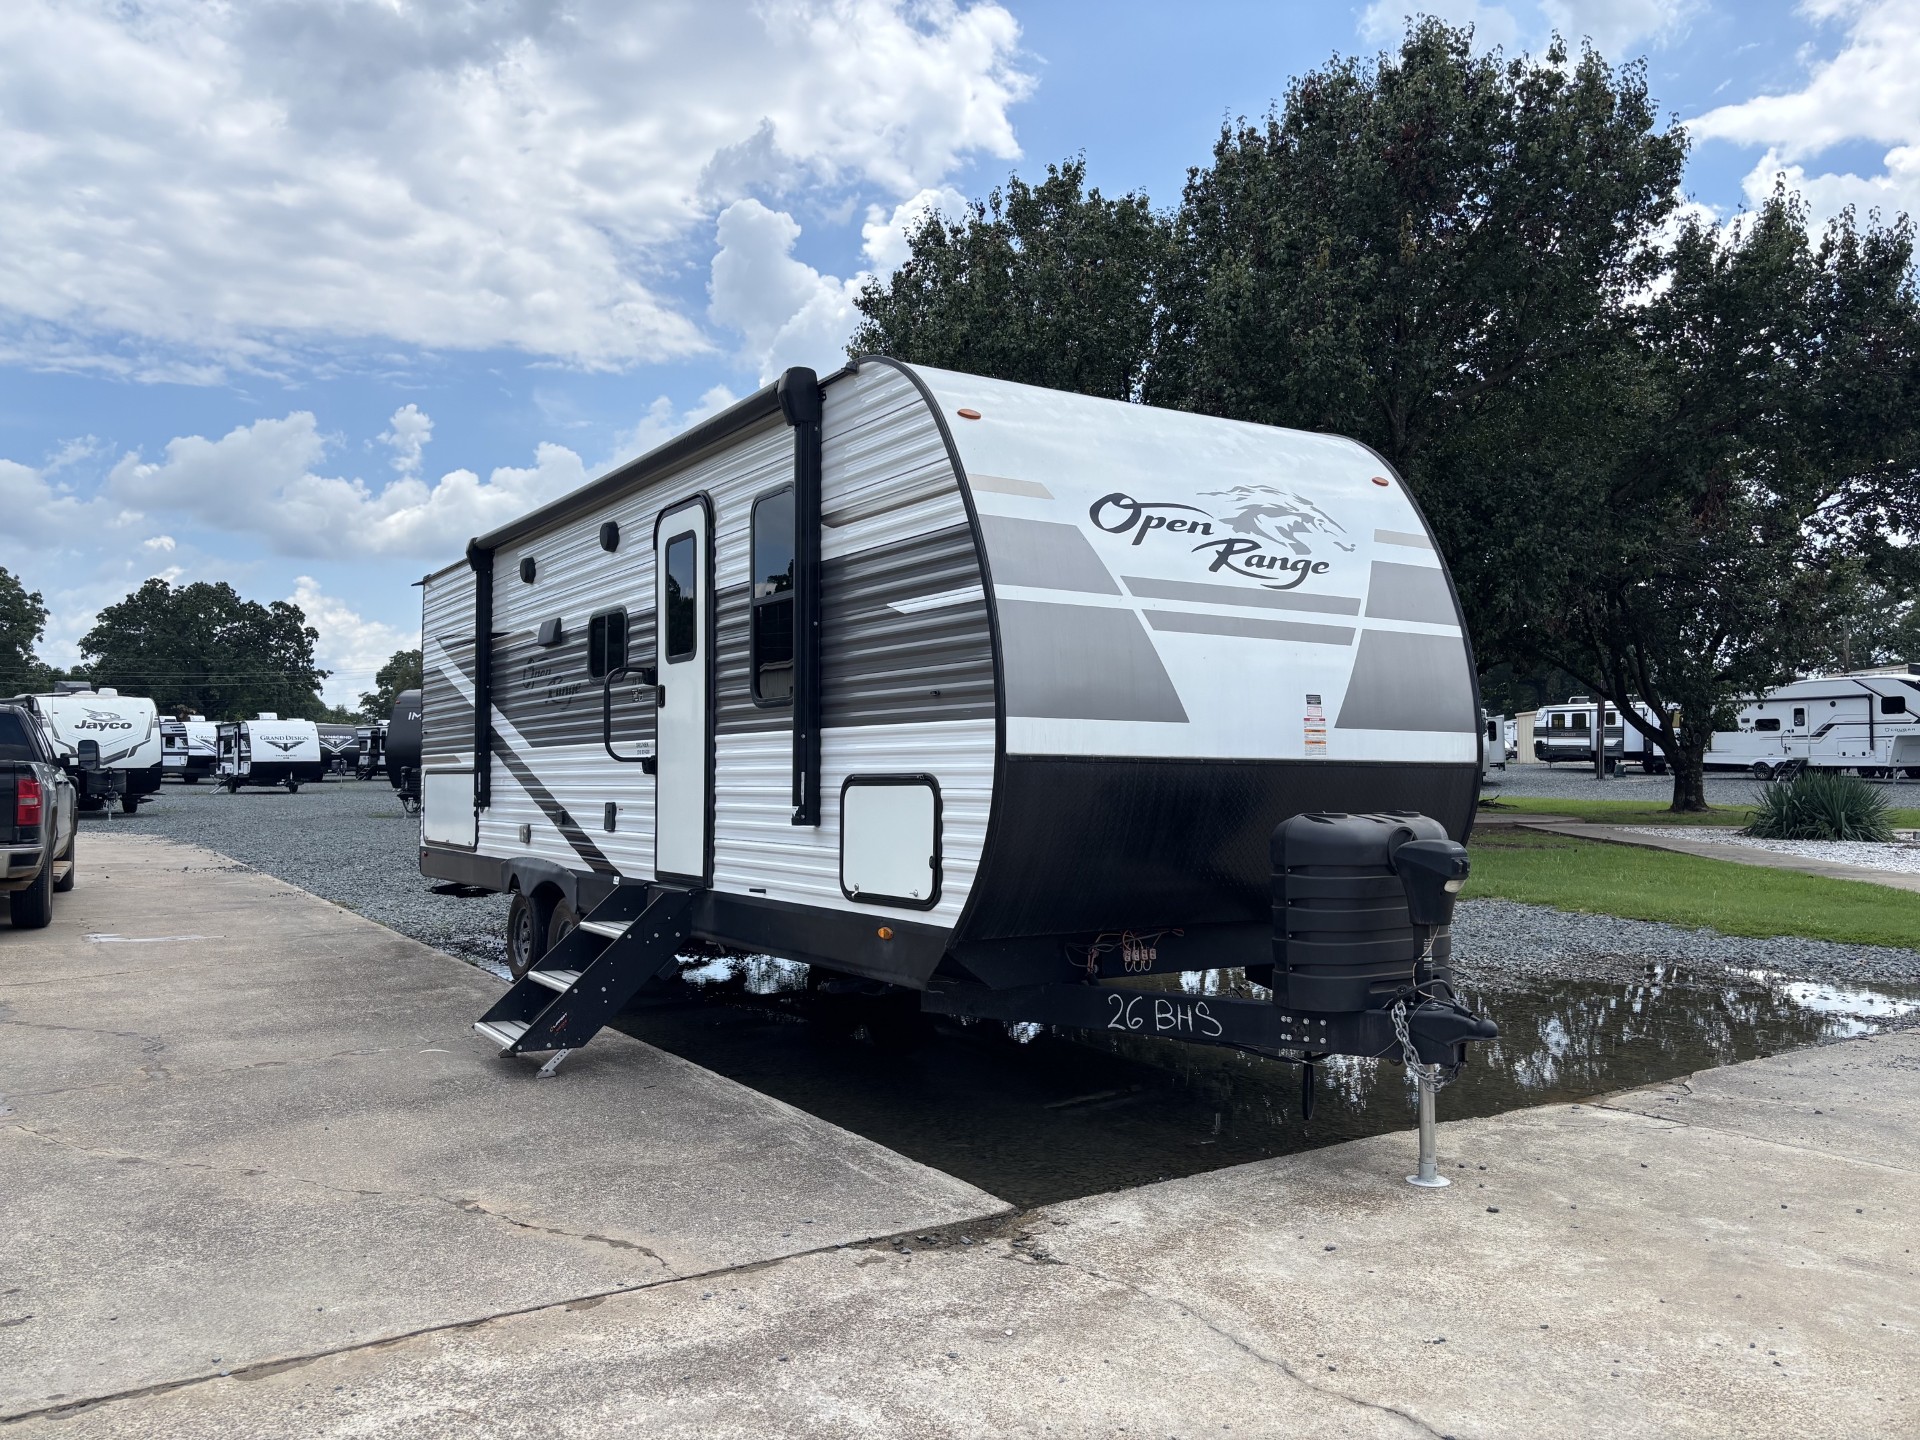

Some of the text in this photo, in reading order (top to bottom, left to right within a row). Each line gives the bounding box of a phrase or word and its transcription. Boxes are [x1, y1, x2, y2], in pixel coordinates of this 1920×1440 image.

[1089, 493, 1214, 546] Open
[1191, 538, 1330, 590] Range
[74, 720, 133, 731] Jayco
[1107, 993, 1223, 1037] 26 BHS
